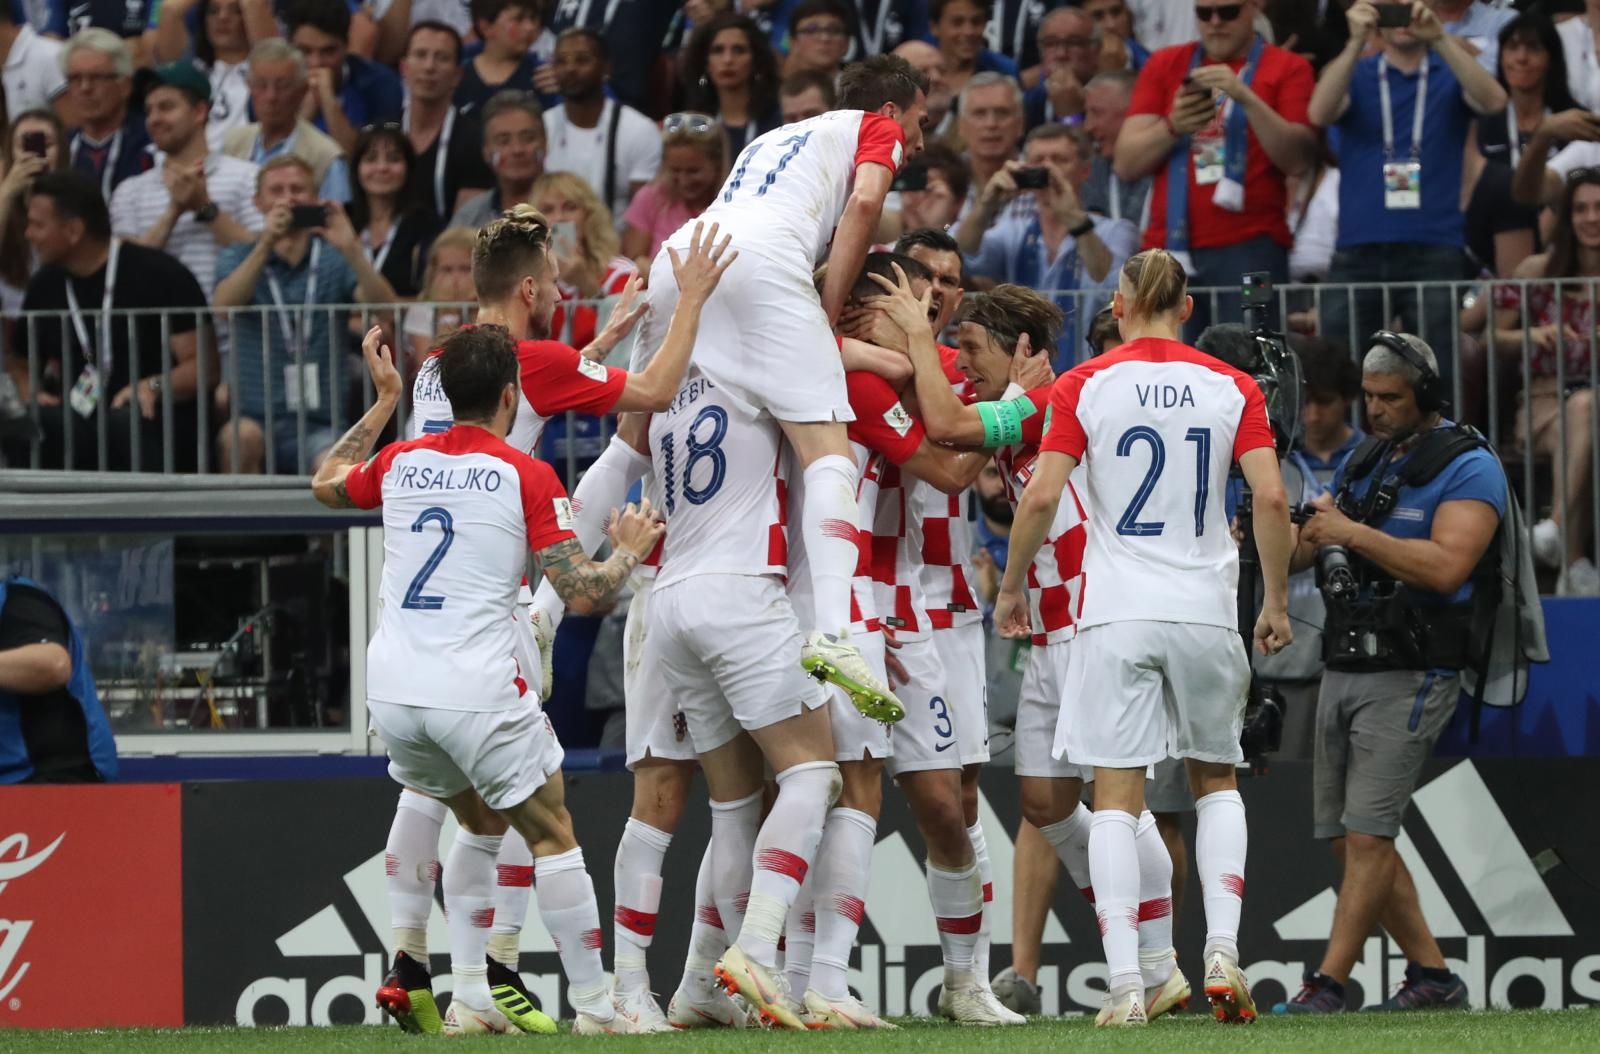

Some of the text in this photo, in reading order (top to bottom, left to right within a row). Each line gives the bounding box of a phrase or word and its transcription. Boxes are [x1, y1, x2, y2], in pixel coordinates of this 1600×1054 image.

[1136, 384, 1196, 409] VIDA
[394, 465, 502, 492] VRSALJKO
[661, 404, 729, 517] 18
[1116, 425, 1212, 538] 21
[401, 506, 455, 610] 2
[929, 695, 953, 739] 3
